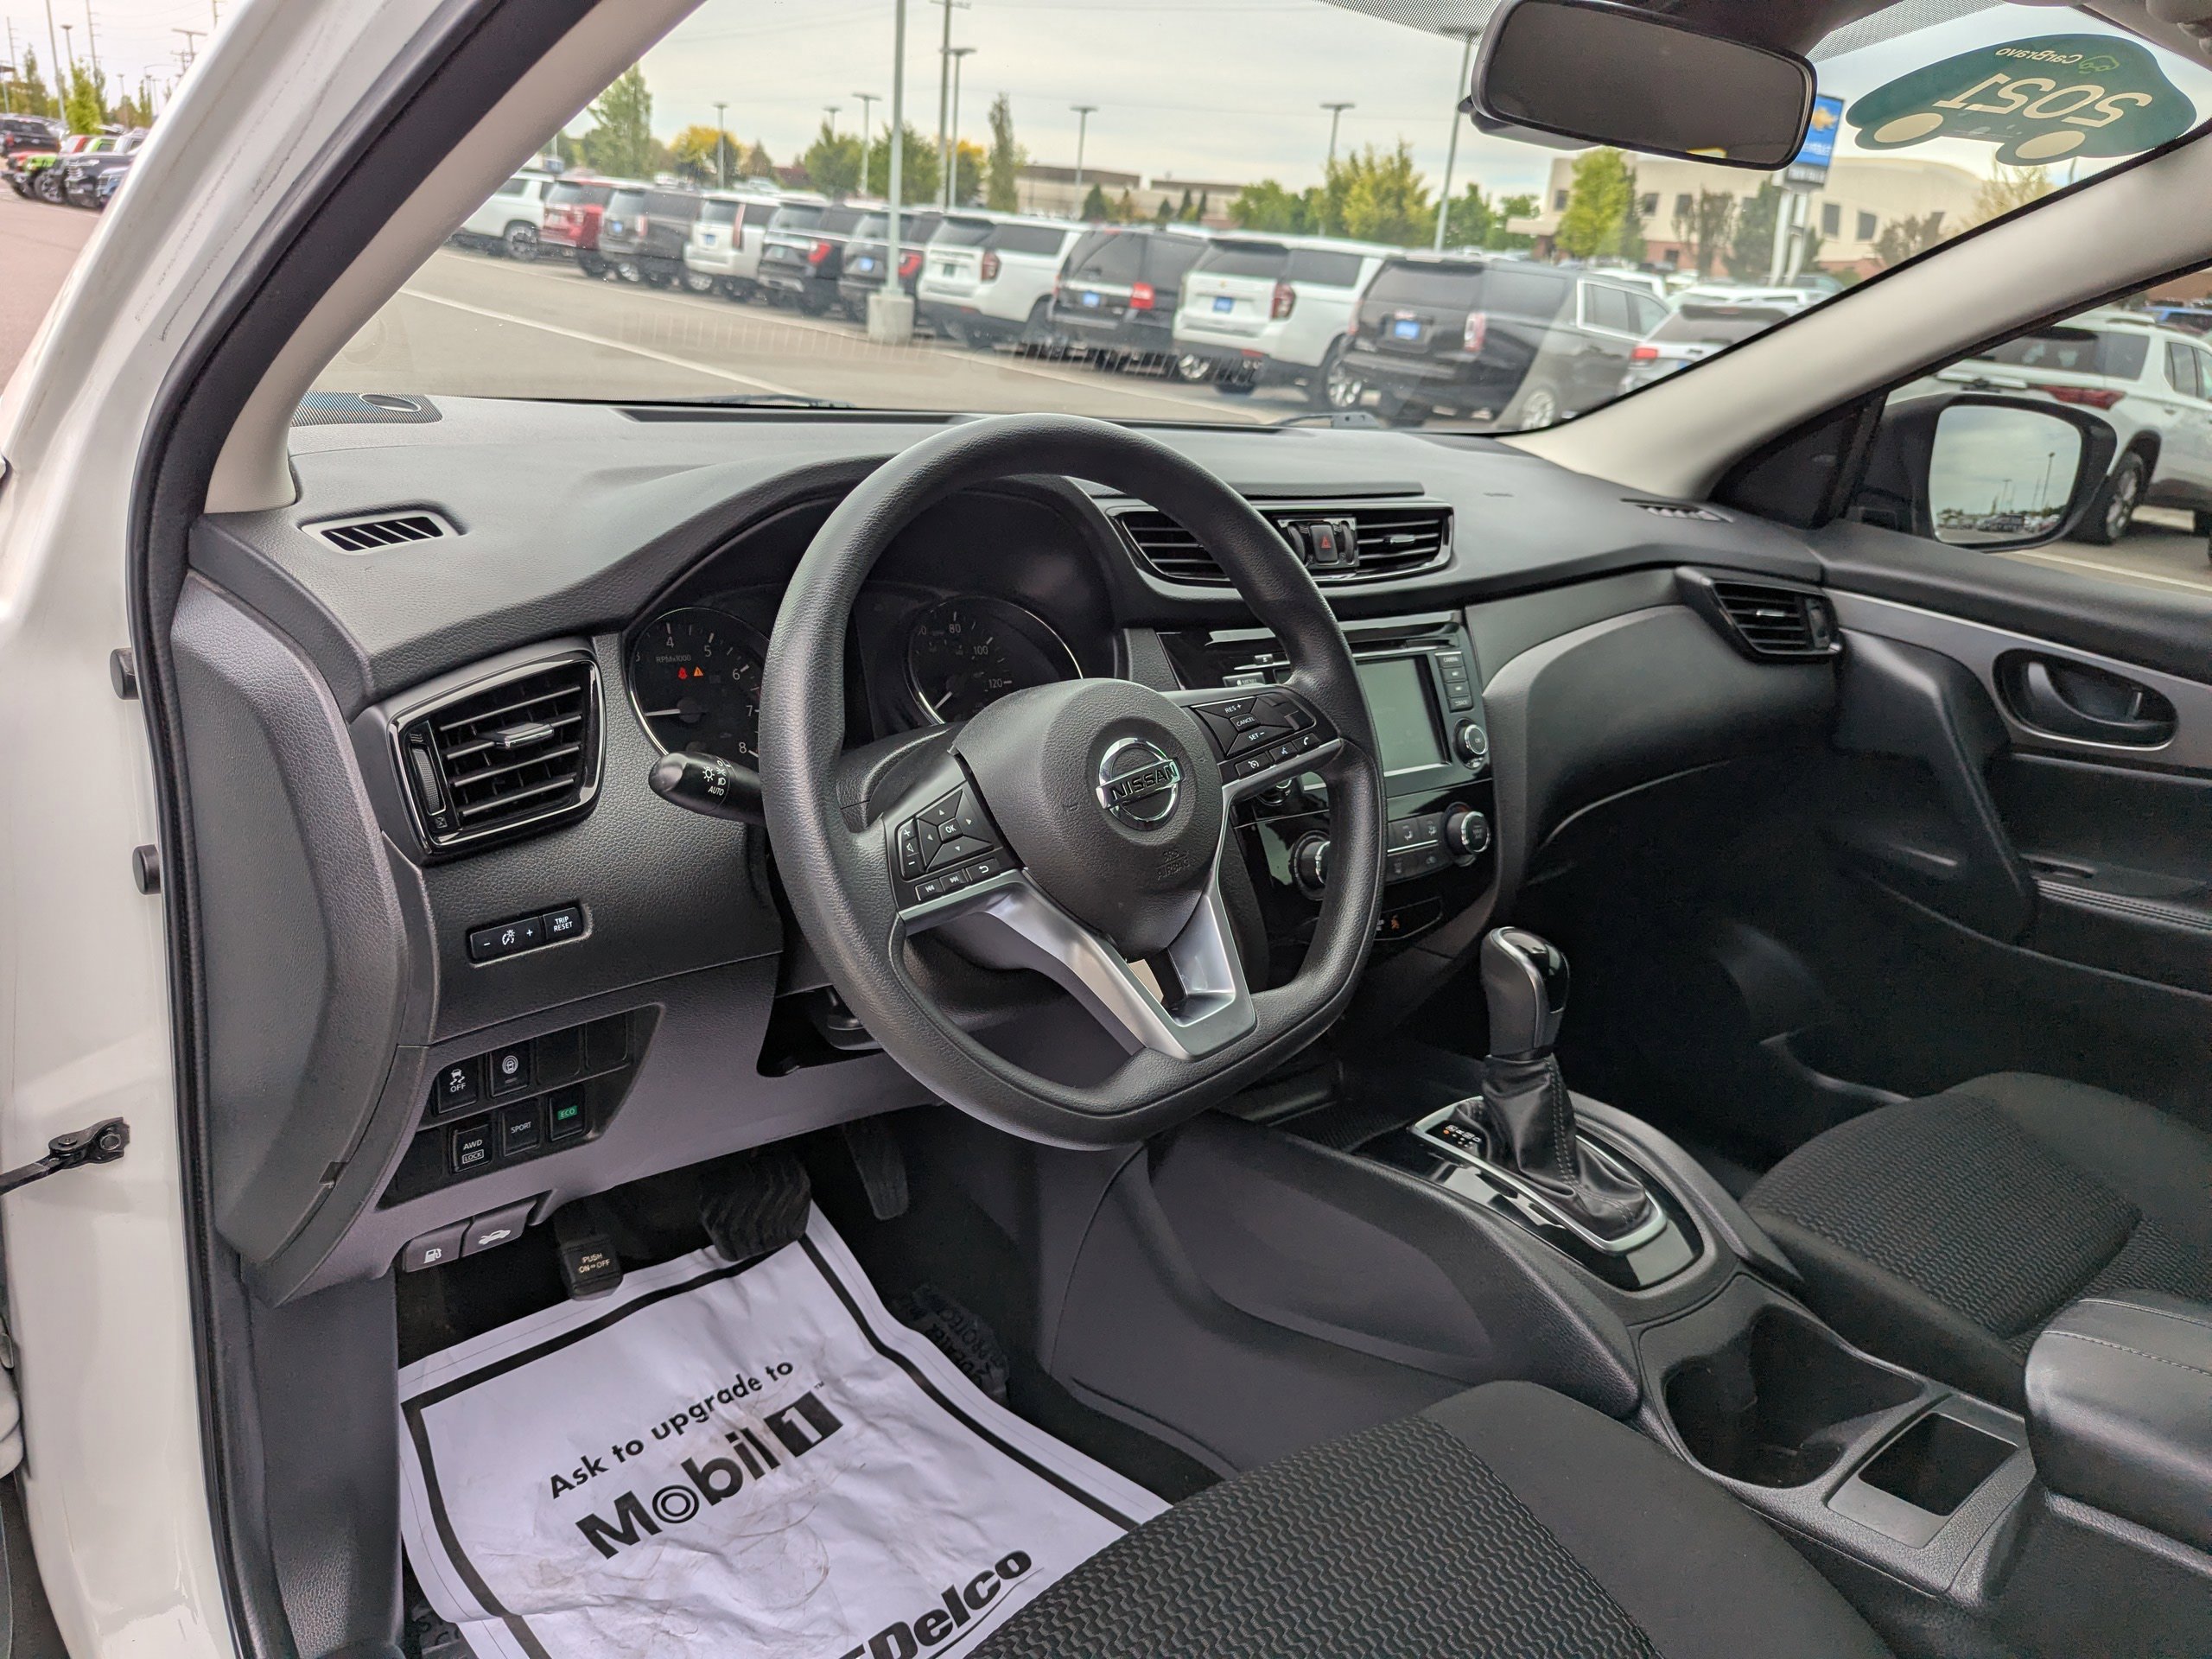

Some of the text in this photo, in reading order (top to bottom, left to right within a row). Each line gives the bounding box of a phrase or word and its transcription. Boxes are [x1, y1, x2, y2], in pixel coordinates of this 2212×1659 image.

[949, 623, 962, 633] 80
[666, 636, 674, 648] 4
[704, 645, 712, 657] 5
[973, 645, 988, 655] 100
[732, 668, 741, 680] 6
[988, 678, 1002, 688] 120
[746, 704, 753, 716] 7
[1224, 705, 1236, 714] RES
[1236, 716, 1255, 727] CANCEL
[1249, 733, 1259, 741] SET
[739, 741, 747, 753] 8
[1109, 761, 1179, 801] NISSAN
[708, 785, 725, 796] AUTO
[944, 824, 957, 834] OK
[555, 916, 569, 925] TRIP
[553, 921, 573, 932] RESET
[450, 1083, 467, 1093] OFF
[561, 1108, 575, 1117] ECO
[511, 1122, 532, 1134] SPORT
[463, 1139, 483, 1150] AWD
[464, 1151, 482, 1162] LOCK
[582, 1253, 603, 1263] PUSH
[550, 1362, 793, 1499] Ask to upgrade to
[575, 1427, 781, 1560] Mobil
[838, 1550, 1032, 1659] Delco
